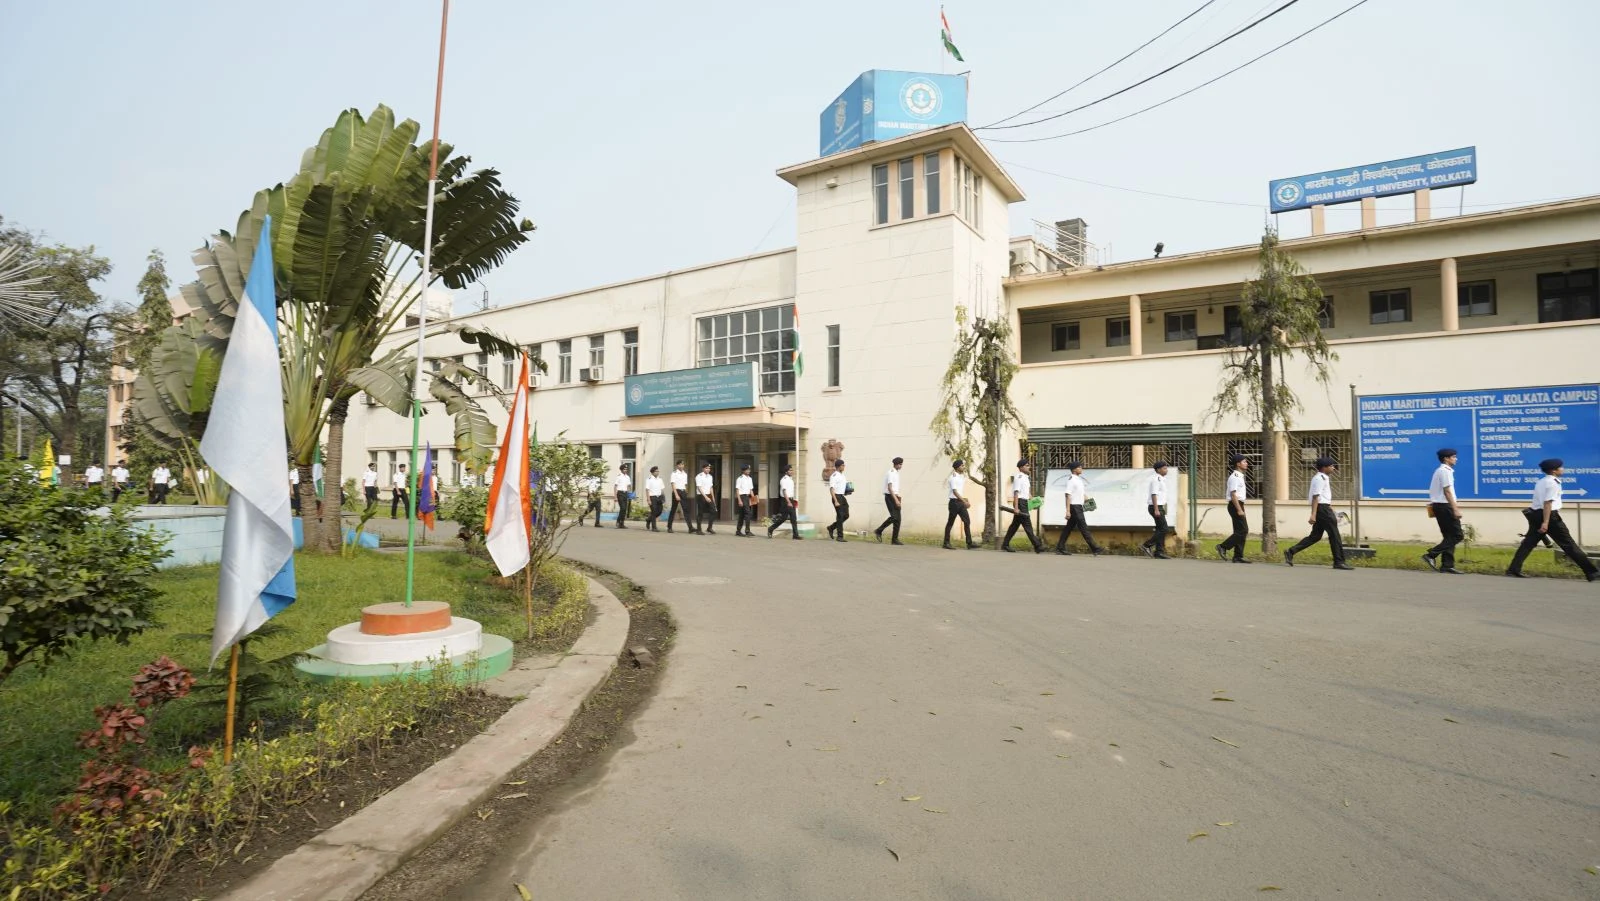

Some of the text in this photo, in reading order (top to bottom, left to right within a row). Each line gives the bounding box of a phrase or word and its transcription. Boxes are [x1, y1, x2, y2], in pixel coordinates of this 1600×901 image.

[1304, 176, 1334, 189] भारतीय
[1305, 170, 1473, 203] INDIAN MARITIME UNIVERSITY, KOLKATA
[1361, 400, 1392, 411] INDIAN
[1393, 398, 1437, 409] MARITIME
[1439, 394, 1496, 408] UNIVERSITY
[1503, 392, 1551, 405] KOLKATA
[1552, 390, 1598, 402] CAMPUS
[1479, 407, 1561, 416] RESIDENTIAL COMPLEX
[1424, 427, 1448, 435] OFFICE
[1532, 424, 1568, 432] BUILDING
